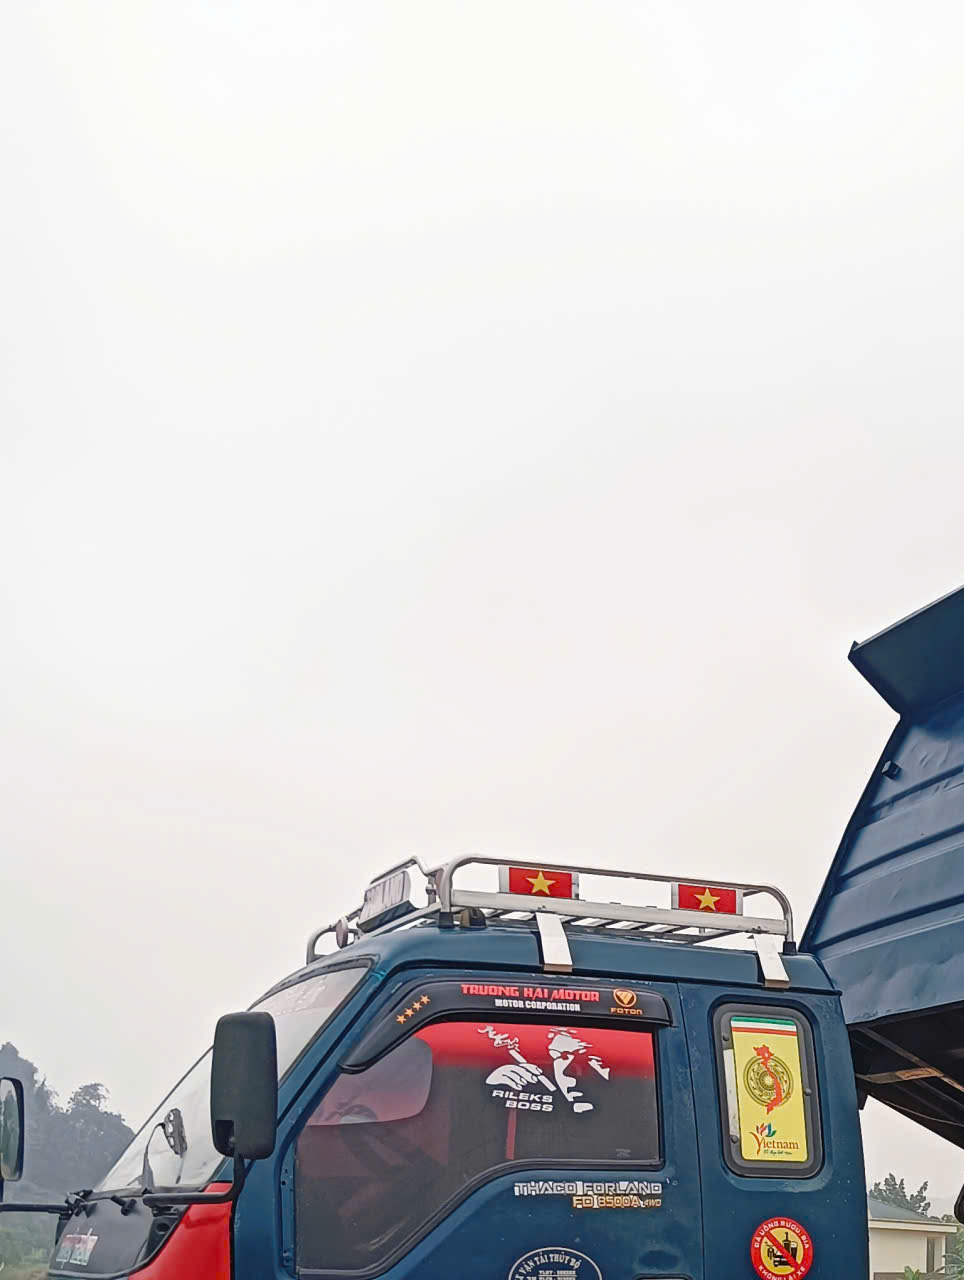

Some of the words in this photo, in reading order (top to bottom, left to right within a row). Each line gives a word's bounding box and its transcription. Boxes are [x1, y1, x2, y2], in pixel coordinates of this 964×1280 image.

[550, 988, 600, 1002] MOTOR
[494, 999, 524, 1009] MOTOR
[525, 1000, 581, 1012] CORPORATION
[491, 1089, 553, 1103] RILEKS
[505, 1100, 554, 1112] BOSS
[514, 1181, 577, 1196] THACO
[583, 1181, 663, 1196] FORLAND
